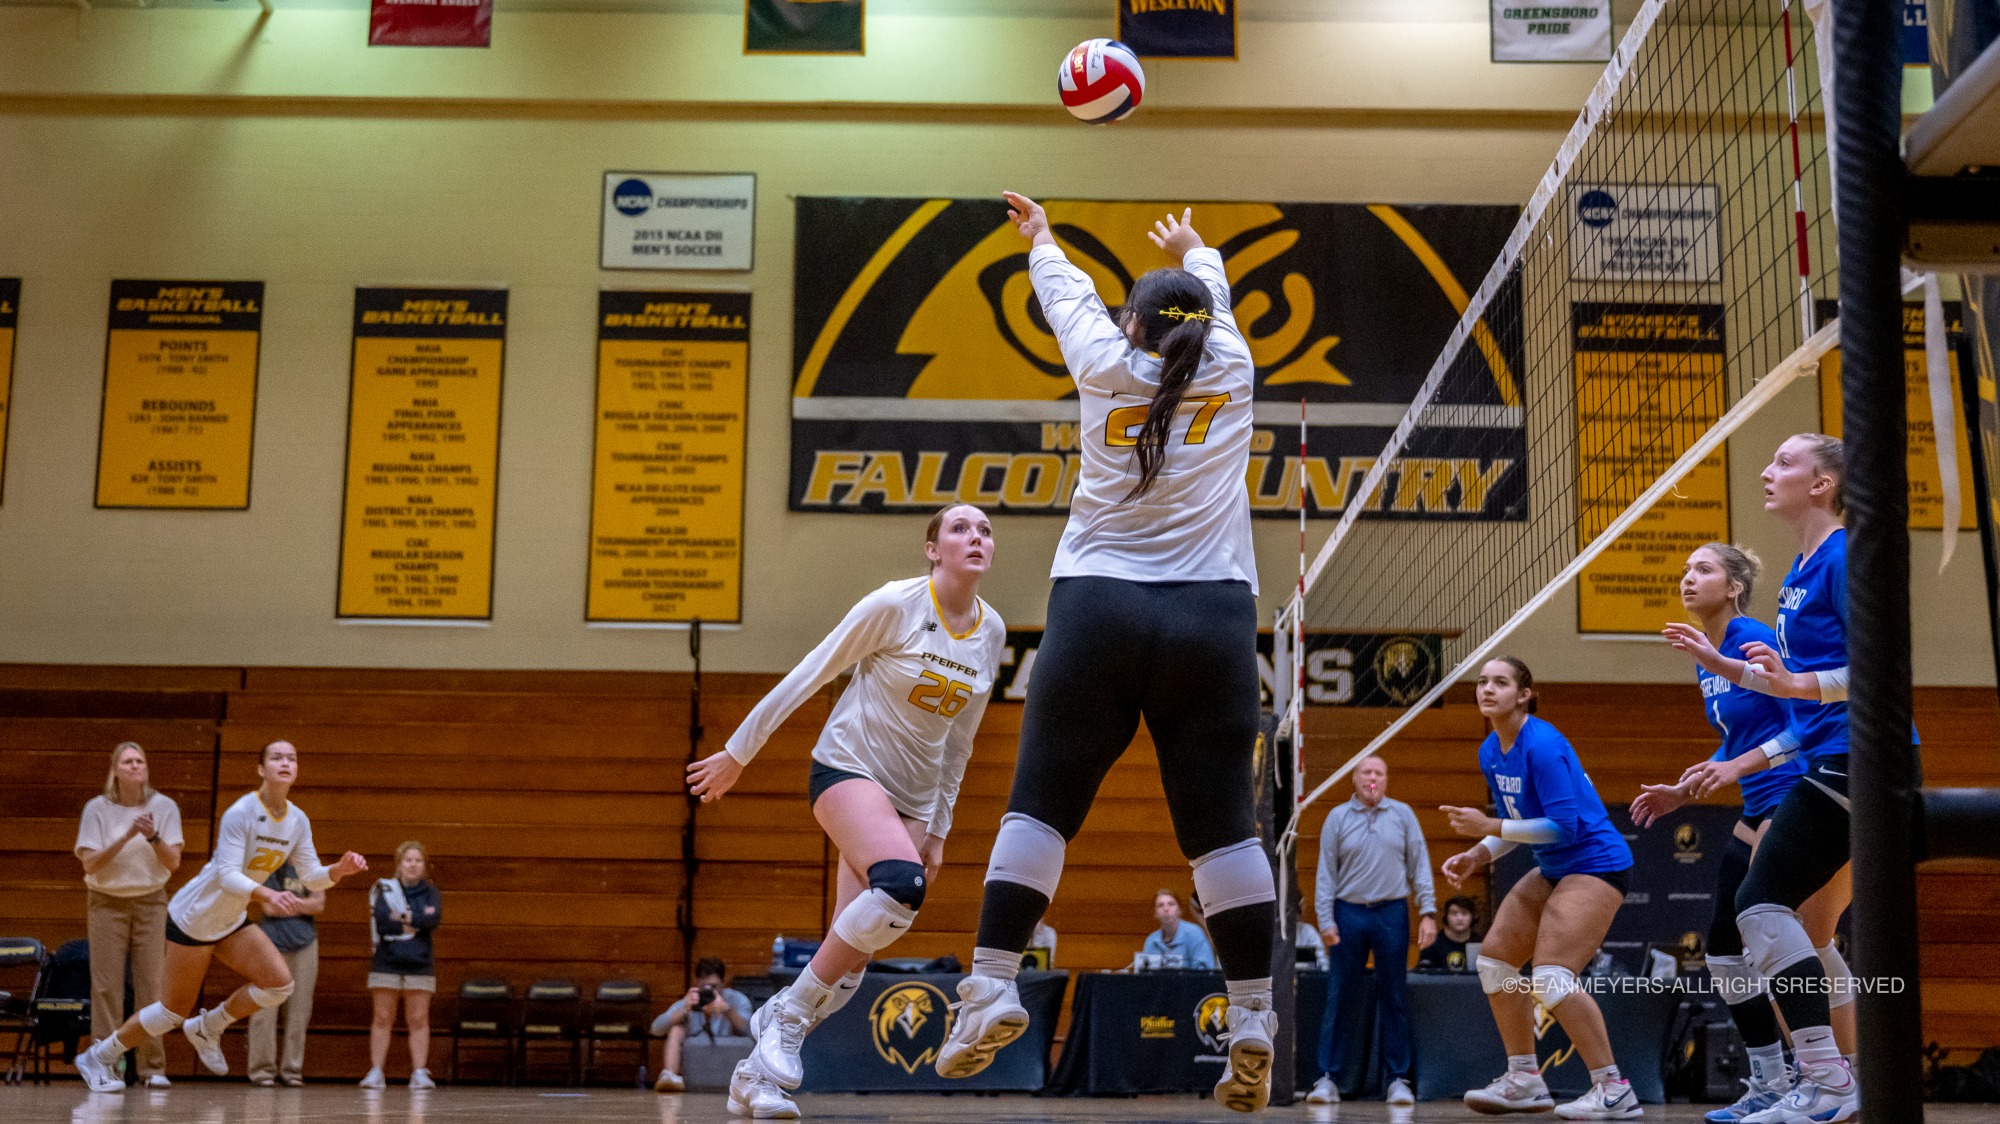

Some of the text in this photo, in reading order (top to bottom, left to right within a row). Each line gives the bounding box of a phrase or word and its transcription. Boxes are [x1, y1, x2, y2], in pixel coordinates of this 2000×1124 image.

[1503, 7, 1599, 19] GREENSBORO
[1527, 22, 1571, 35] PRIDE
[657, 197, 748, 210] CHAMPIONSHIPS
[667, 229, 702, 241] NCAA
[632, 244, 723, 257] MEN'S SOCCER
[157, 286, 224, 300] MEN'S
[117, 298, 259, 313] BASKETBALL
[401, 300, 470, 312] MEN'S
[643, 302, 711, 316] MEN'S
[361, 311, 504, 325] BASKETBALL
[604, 314, 747, 329] BASKETBALL
[159, 340, 208, 351] POINTS
[387, 355, 470, 365] CHAMPIONSHIP
[614, 359, 732, 371] TOURNAMENT CHAMPS
[376, 366, 478, 378] GAME APPEARANCE
[142, 399, 216, 412] REBOUNDS
[394, 409, 457, 419] FINAL FOUR
[652, 412, 695, 422] SEASON
[696, 413, 739, 423] CHAMPS
[1104, 391, 1232, 447] 27
[386, 421, 462, 431] APPEARANCES
[611, 453, 729, 464] TOURNAMENT CHAMPS
[148, 460, 202, 472] ASSISTS
[371, 463, 472, 474] REGIONAL CHAMPS
[801, 451, 1080, 508] FALCO
[1245, 456, 1514, 513] UNTRY
[614, 483, 644, 493] NCAA
[631, 495, 705, 506] APPEARANCES
[1677, 501, 1722, 510] CHAMPS
[364, 506, 413, 516] DISTRICT
[429, 507, 474, 517] CHAMPS
[597, 536, 738, 548] TOURNAMENT APPEARANCES
[1659, 532, 1719, 542] CAROLINAS
[370, 549, 464, 560] REGULAR SEASON
[1635, 544, 1677, 553] SEASON
[393, 561, 440, 572] CHAMPS
[1588, 573, 1657, 583] CONFERENCE
[652, 580, 725, 591] TOURNAMENT
[1595, 585, 1668, 596] TOURNAMENT
[641, 591, 687, 602] CHAMPS
[920, 652, 979, 679] PFEIFFER
[907, 669, 973, 718] 26
[1712, 700, 1729, 736] 1
[247, 847, 285, 873] 20
